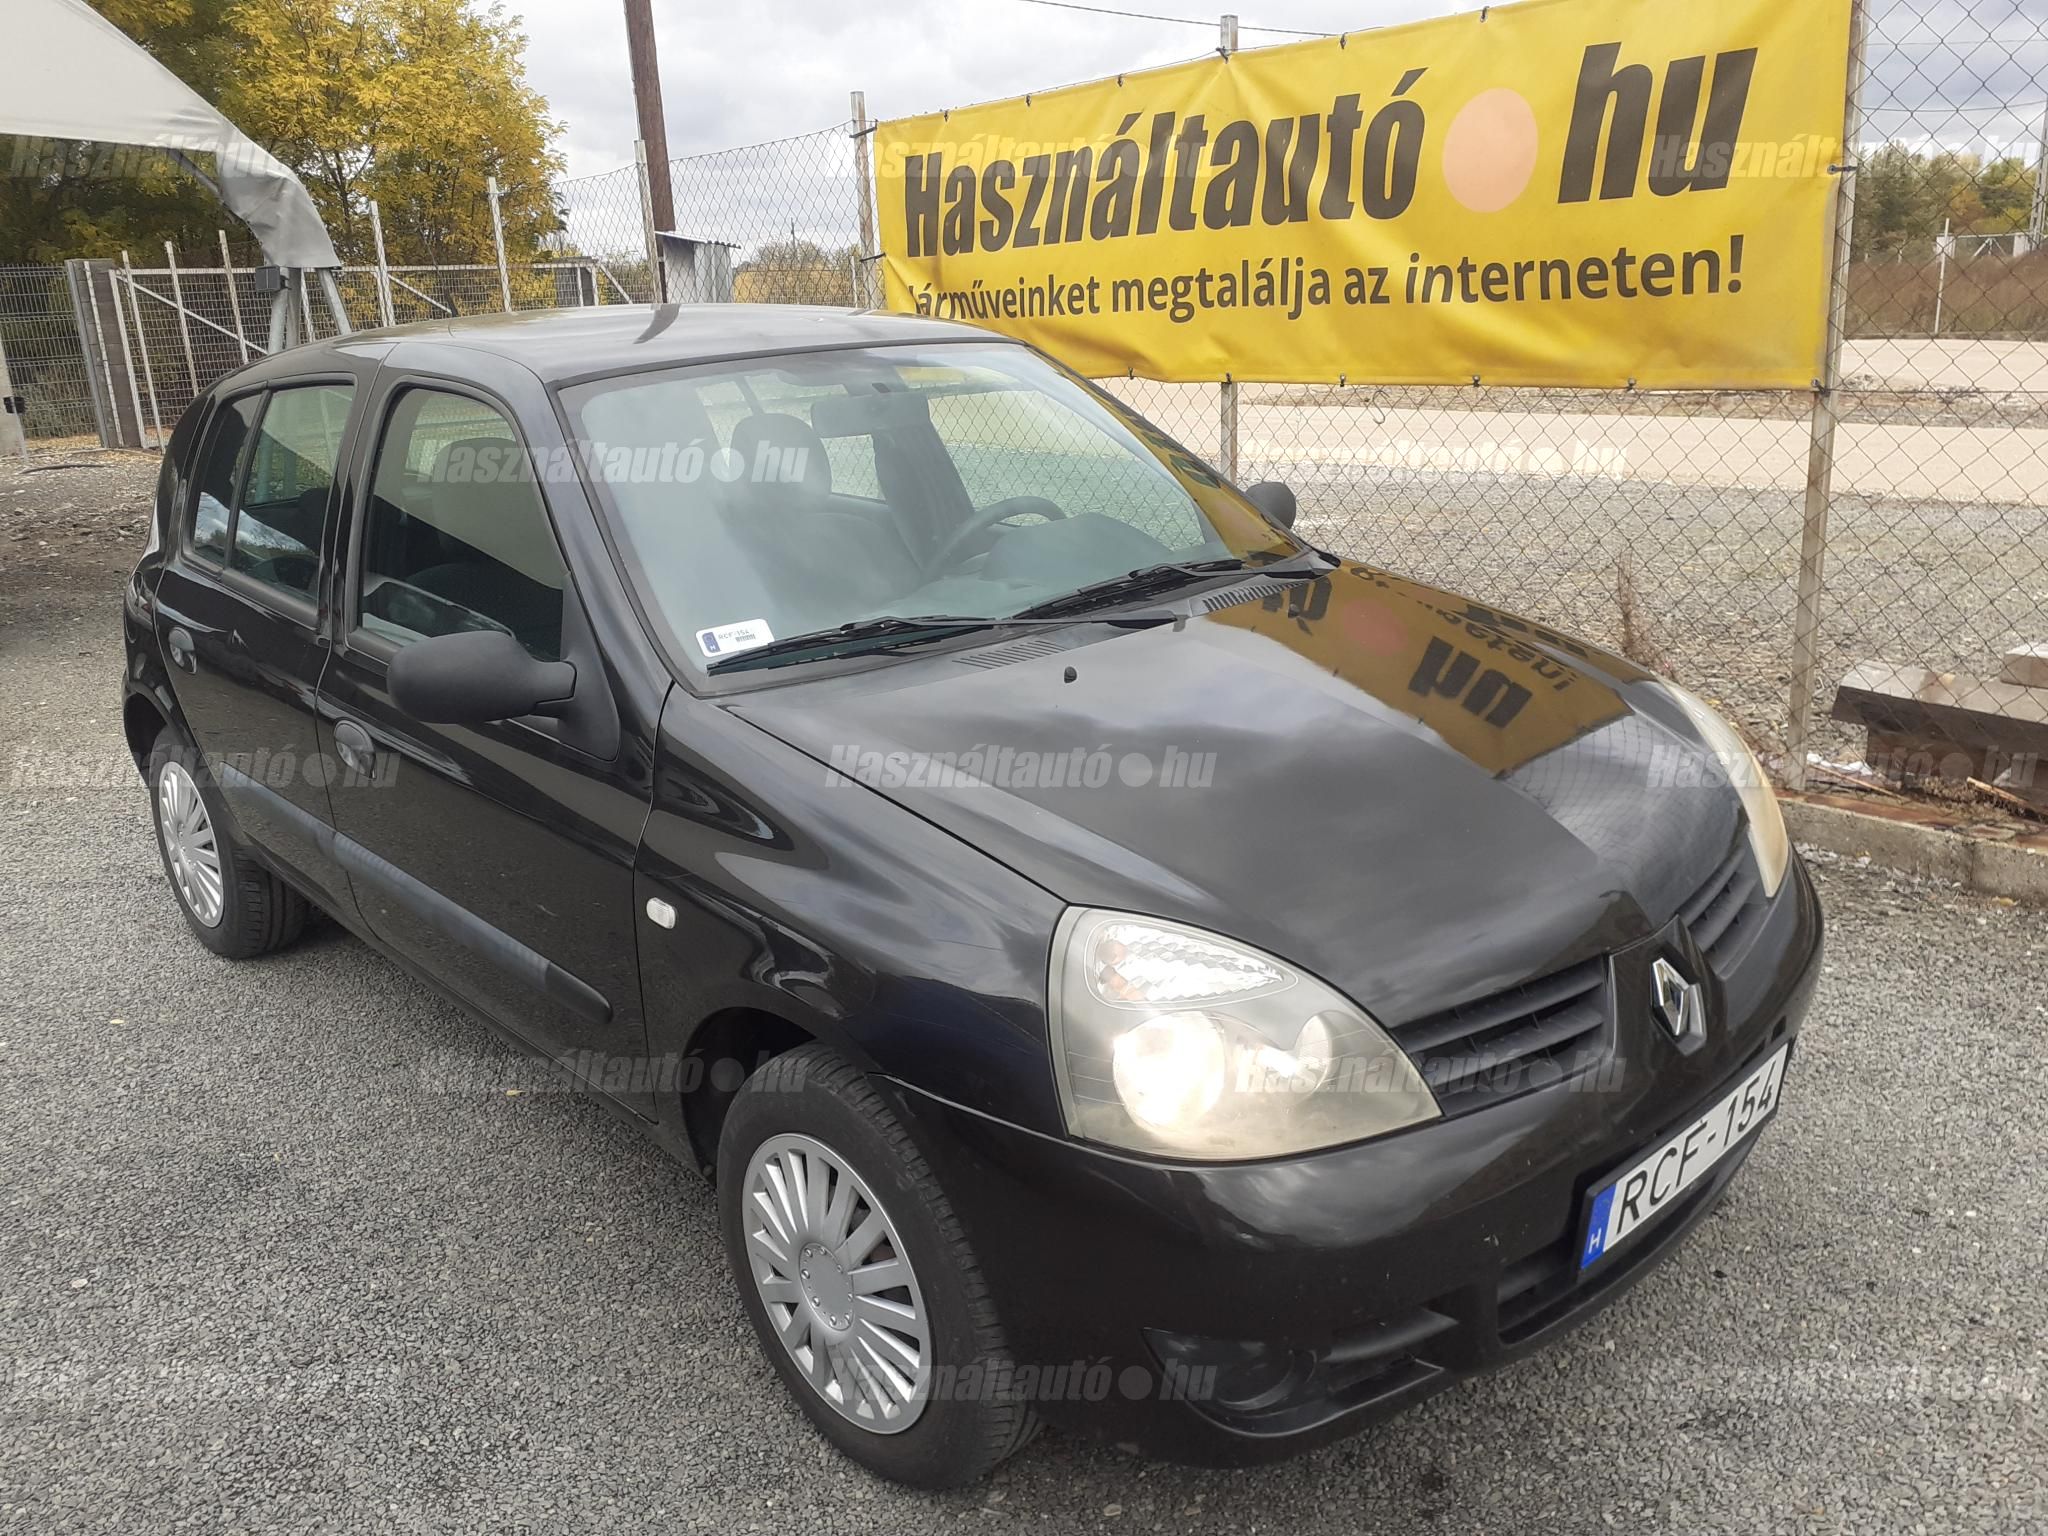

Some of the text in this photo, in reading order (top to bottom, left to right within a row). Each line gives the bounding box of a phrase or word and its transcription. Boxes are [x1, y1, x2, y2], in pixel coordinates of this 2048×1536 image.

[904, 41, 1758, 258] Használtautó hu
[1112, 257, 1331, 323] megtalálja
[1344, 266, 1390, 304] az
[1405, 234, 1744, 303] interneten!
[1616, 1060, 1776, 1234] RCF-154
[1588, 1228, 1602, 1254] H
